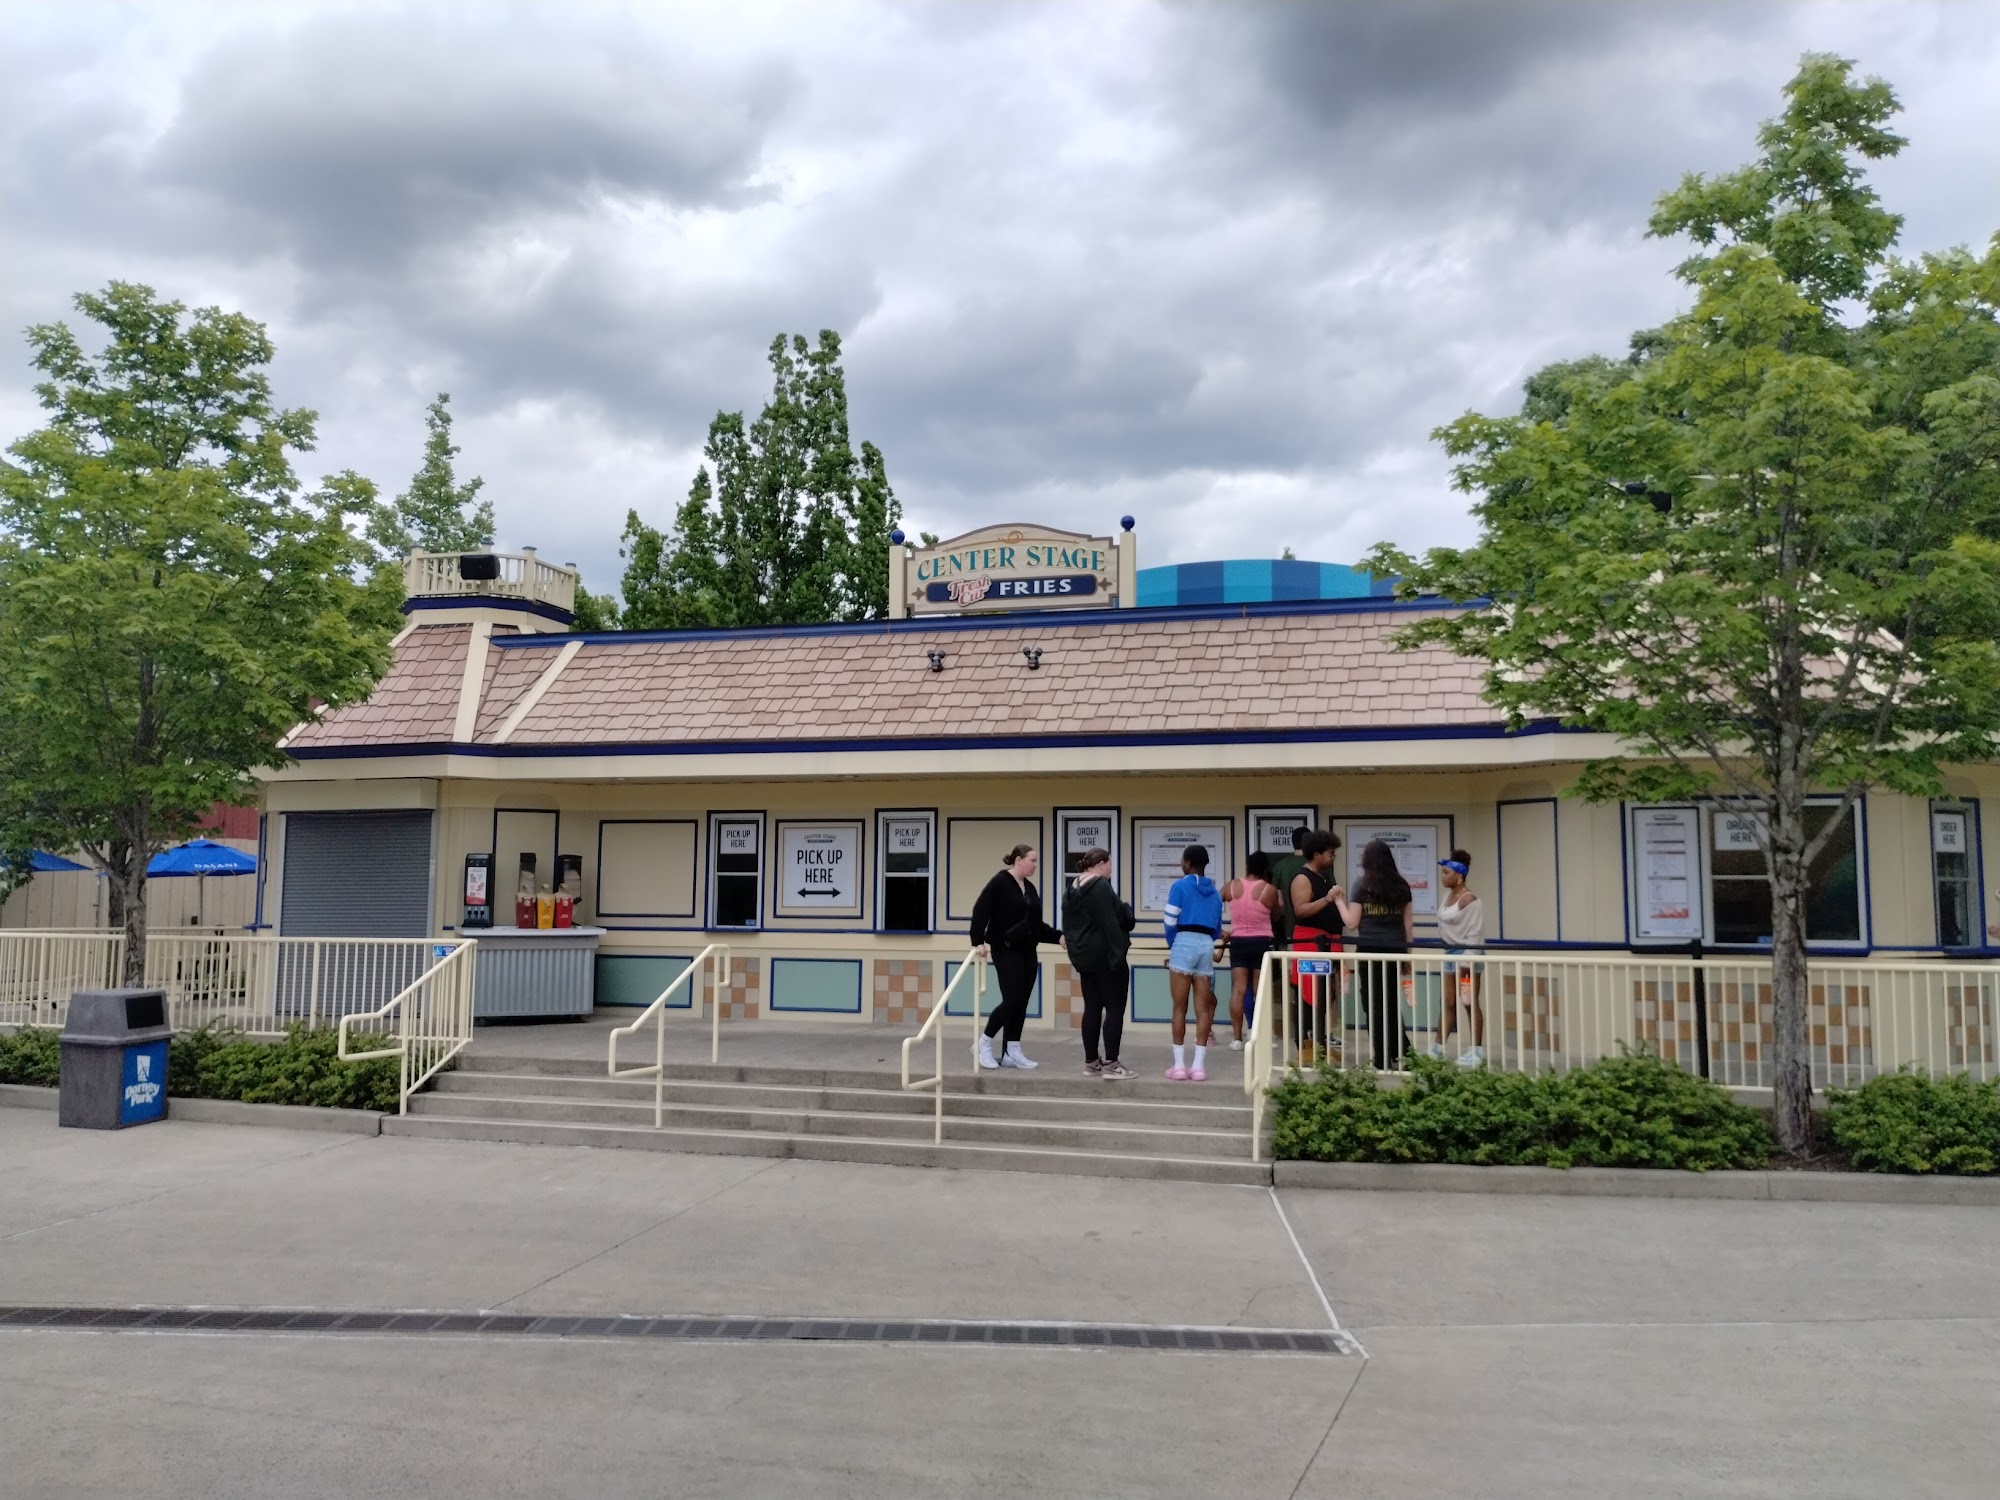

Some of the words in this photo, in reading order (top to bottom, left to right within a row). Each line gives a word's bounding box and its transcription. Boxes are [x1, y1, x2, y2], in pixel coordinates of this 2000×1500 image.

[917, 546, 1016, 581] CENTER
[1026, 545, 1106, 573] STAGE
[947, 575, 991, 600] Fresh
[999, 578, 1072, 596] FRIES
[959, 591, 985, 606] Cut
[726, 829, 741, 838] PICK
[742, 829, 751, 838] UP
[894, 828, 910, 837] PICK
[911, 828, 921, 837] UP
[1076, 826, 1099, 836] ORDER
[730, 839, 746, 848] HERE
[899, 838, 916, 847] HERE
[1079, 837, 1096, 846] HERE
[1272, 836, 1292, 846] HERE
[797, 849, 824, 865] PICK
[827, 849, 843, 865] UP
[805, 867, 834, 883] HERE
[125, 1082, 161, 1101] Dorney
[131, 1093, 154, 1108] Park
